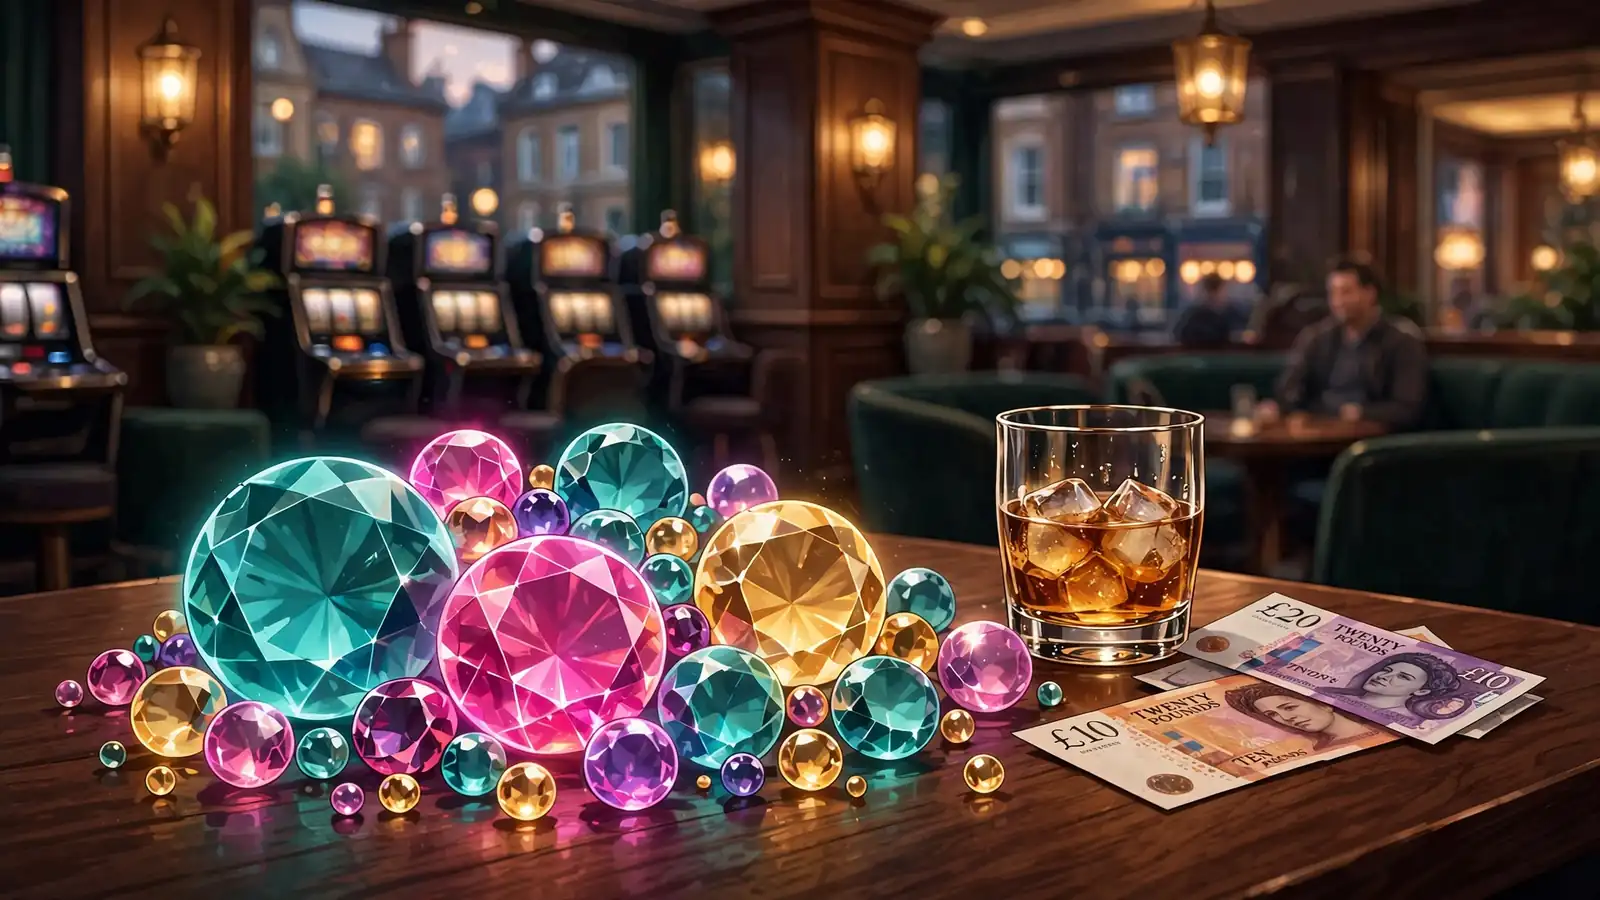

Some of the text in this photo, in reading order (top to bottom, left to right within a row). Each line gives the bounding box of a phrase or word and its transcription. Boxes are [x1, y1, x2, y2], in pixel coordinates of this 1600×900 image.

[1256, 602, 1321, 628] £20
[1333, 623, 1405, 650] TWENTY
[1334, 634, 1389, 656] POUNDS
[1458, 667, 1510, 689] £10
[1130, 691, 1213, 720] TWENTY
[1051, 720, 1120, 750] £10
[1231, 749, 1274, 766] TEN
